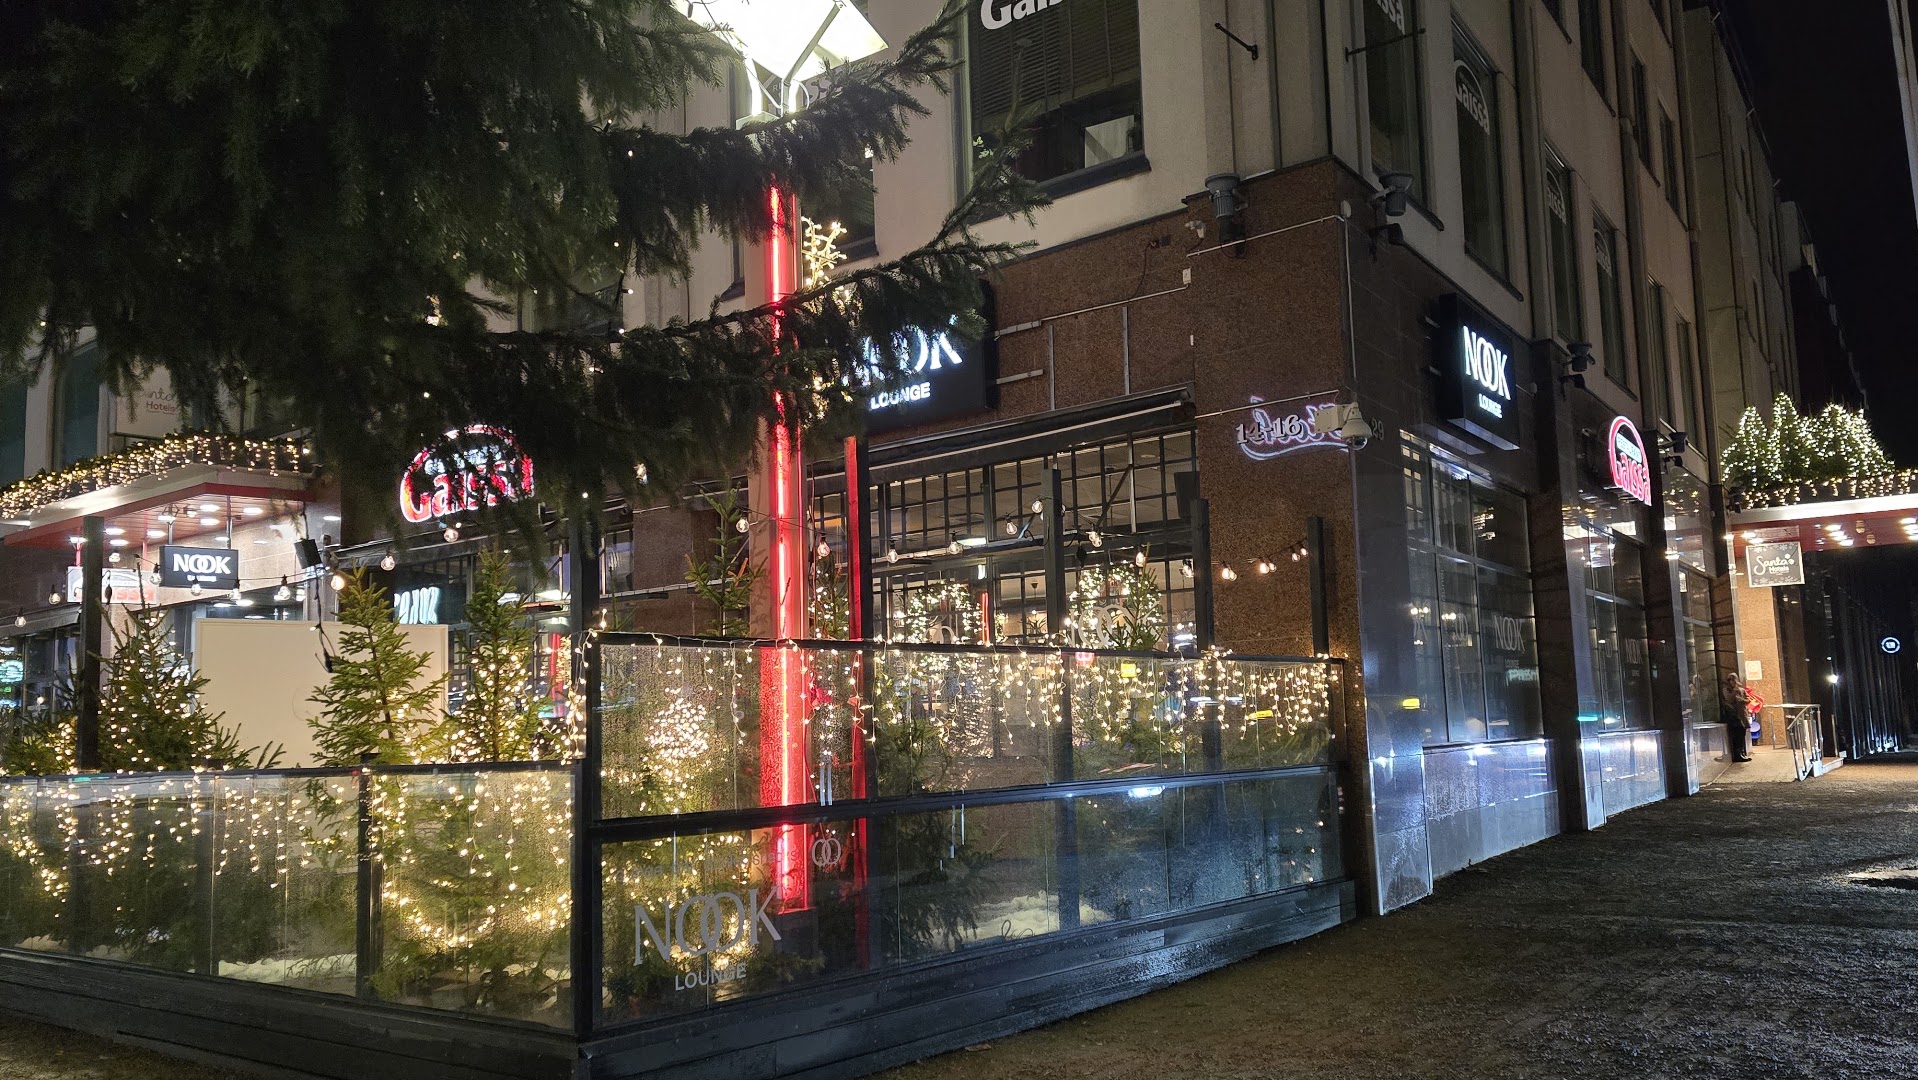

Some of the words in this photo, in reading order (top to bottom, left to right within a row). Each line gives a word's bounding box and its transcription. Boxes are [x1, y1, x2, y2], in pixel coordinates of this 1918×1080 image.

[1463, 325, 1511, 401] NOOK
[145, 401, 176, 413] Hotels
[869, 381, 931, 411] LOUNGE
[1236, 414, 1303, 445] 14-16
[1371, 417, 1385, 441] 29
[173, 553, 232, 575] NOOK
[1753, 555, 1790, 576] Santa
[1494, 614, 1526, 652] NOOK
[633, 886, 783, 967] NOOK
[674, 961, 748, 992] LOUNGE
